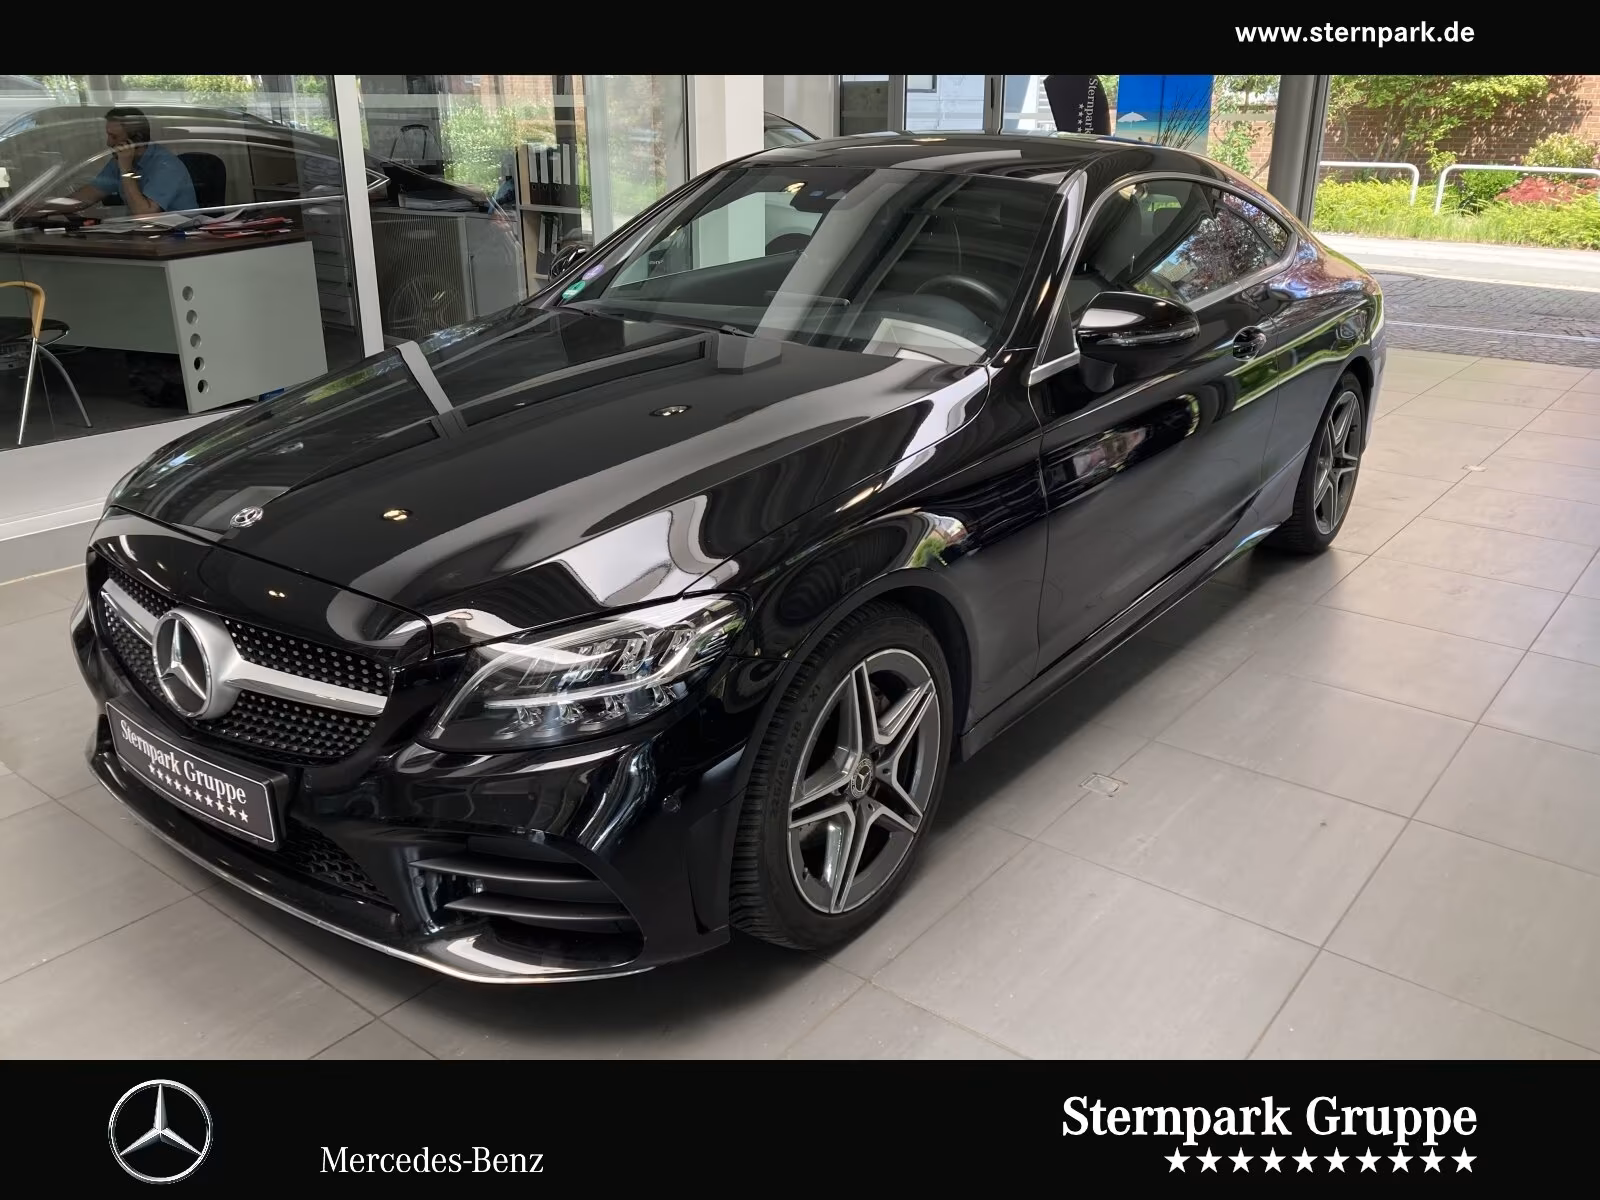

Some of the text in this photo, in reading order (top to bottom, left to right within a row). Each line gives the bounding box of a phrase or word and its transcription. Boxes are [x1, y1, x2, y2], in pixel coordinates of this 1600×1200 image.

[1084, 78, 1098, 134] Sternpark
[120, 719, 247, 804] Sternpark Gruppe
